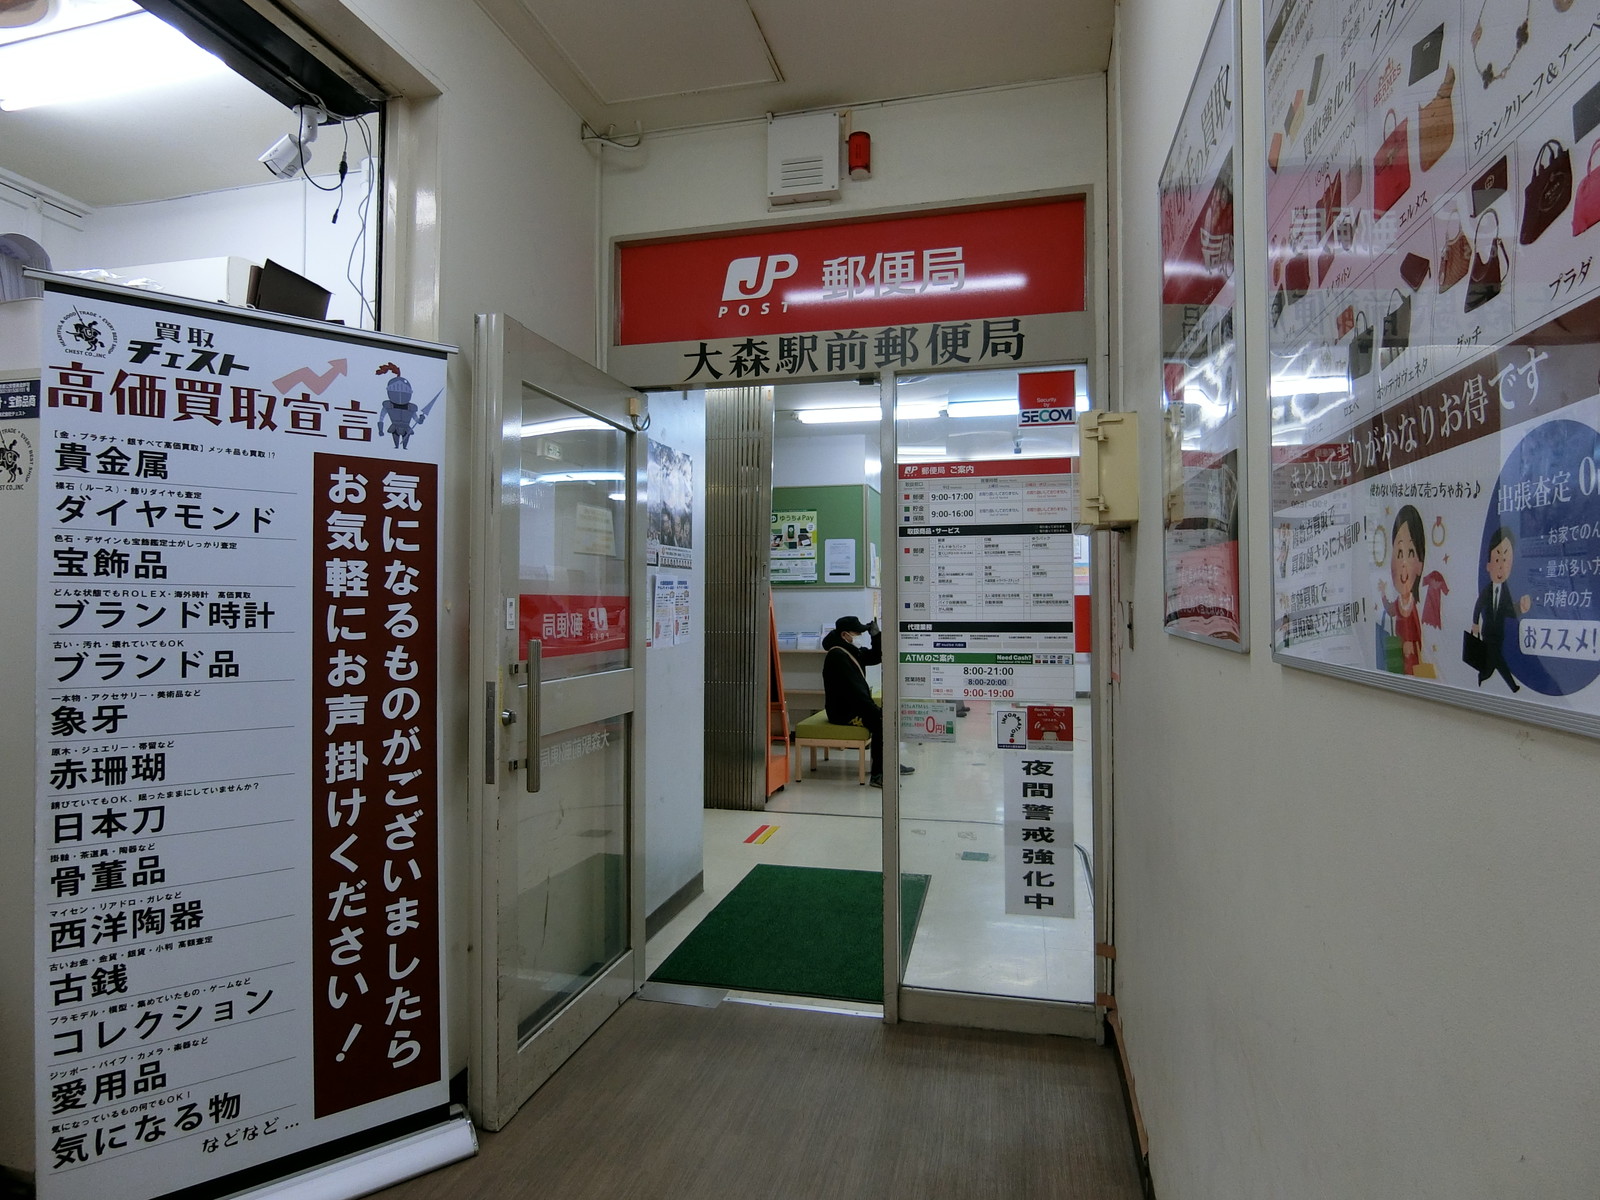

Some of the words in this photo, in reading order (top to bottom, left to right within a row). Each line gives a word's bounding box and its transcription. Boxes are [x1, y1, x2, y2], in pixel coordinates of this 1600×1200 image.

[1304, 62, 1356, 165] 買取強化中
[1371, 0, 1406, 56] ブラ
[1373, 63, 1402, 108] HERMES
[1315, 158, 1331, 187] LOUIS
[1331, 115, 1356, 161] VUITTON
[1399, 190, 1428, 228] エルメス
[722, 253, 799, 302] JP
[822, 246, 966, 301] 郵便局
[1549, 255, 1593, 299] プラダ
[79, 310, 97, 318] TRADE
[102, 318, 114, 331] EVERY
[717, 303, 791, 318] POST
[154, 321, 215, 349] 買取
[683, 318, 1026, 382] 大森駅前郵便局
[127, 339, 250, 377] チェスト
[47, 361, 378, 443] 高価買取宣言
[1021, 408, 1073, 424] SECOM
[1291, 347, 1550, 497] まとめて売りがかなりお得です
[55, 442, 168, 480] 貴金属
[921, 466, 946, 475] 郵便局
[950, 465, 975, 475] ご案内
[931, 492, 974, 501] 9:00-17:00
[1497, 471, 1572, 515] 出張査定
[1578, 456, 1600, 497] 0
[56, 494, 276, 533] ダイヤモンド
[907, 528, 960, 536] 取扱商品・サービス
[931, 510, 974, 518] 9:00-16:00
[53, 547, 168, 579] 宝飾品
[54, 598, 275, 630] ブランド時計
[217, 591, 251, 599] 高価買取
[52, 640, 185, 649] 古い・汚れ・壊れていてもOK
[905, 654, 955, 662] ATMのご案内
[1523, 625, 1597, 655] おススメ!
[54, 650, 240, 682] ブランド品
[963, 666, 1014, 676] 8:00-21:00
[963, 689, 1014, 697] 9:00-19:00
[50, 704, 129, 737] 象牙
[1001, 712, 1022, 738] INFORMATION
[51, 740, 175, 756] 原木・ジュエリー・帯留など
[324, 466, 369, 1062] お気軽にお声掛けください！
[50, 752, 167, 790] 赤珊瑚
[381, 471, 424, 1069] 気になるものがございましたら
[53, 805, 166, 844] 日本刀
[1021, 759, 1055, 910] 夜間警戒強化中
[50, 843, 156, 863] 掛軸・茶道具・陶器など
[50, 854, 166, 898] 骨董品
[49, 891, 183, 918] マイセン・リアドロ・ガレなど
[49, 899, 204, 953] 西洋陶器
[177, 935, 214, 950] 高額査定
[49, 962, 129, 1007] 古銭
[52, 989, 274, 1057] コレクション
[51, 1060, 167, 1116] 愛用品
[51, 1092, 242, 1170] 気になる物
